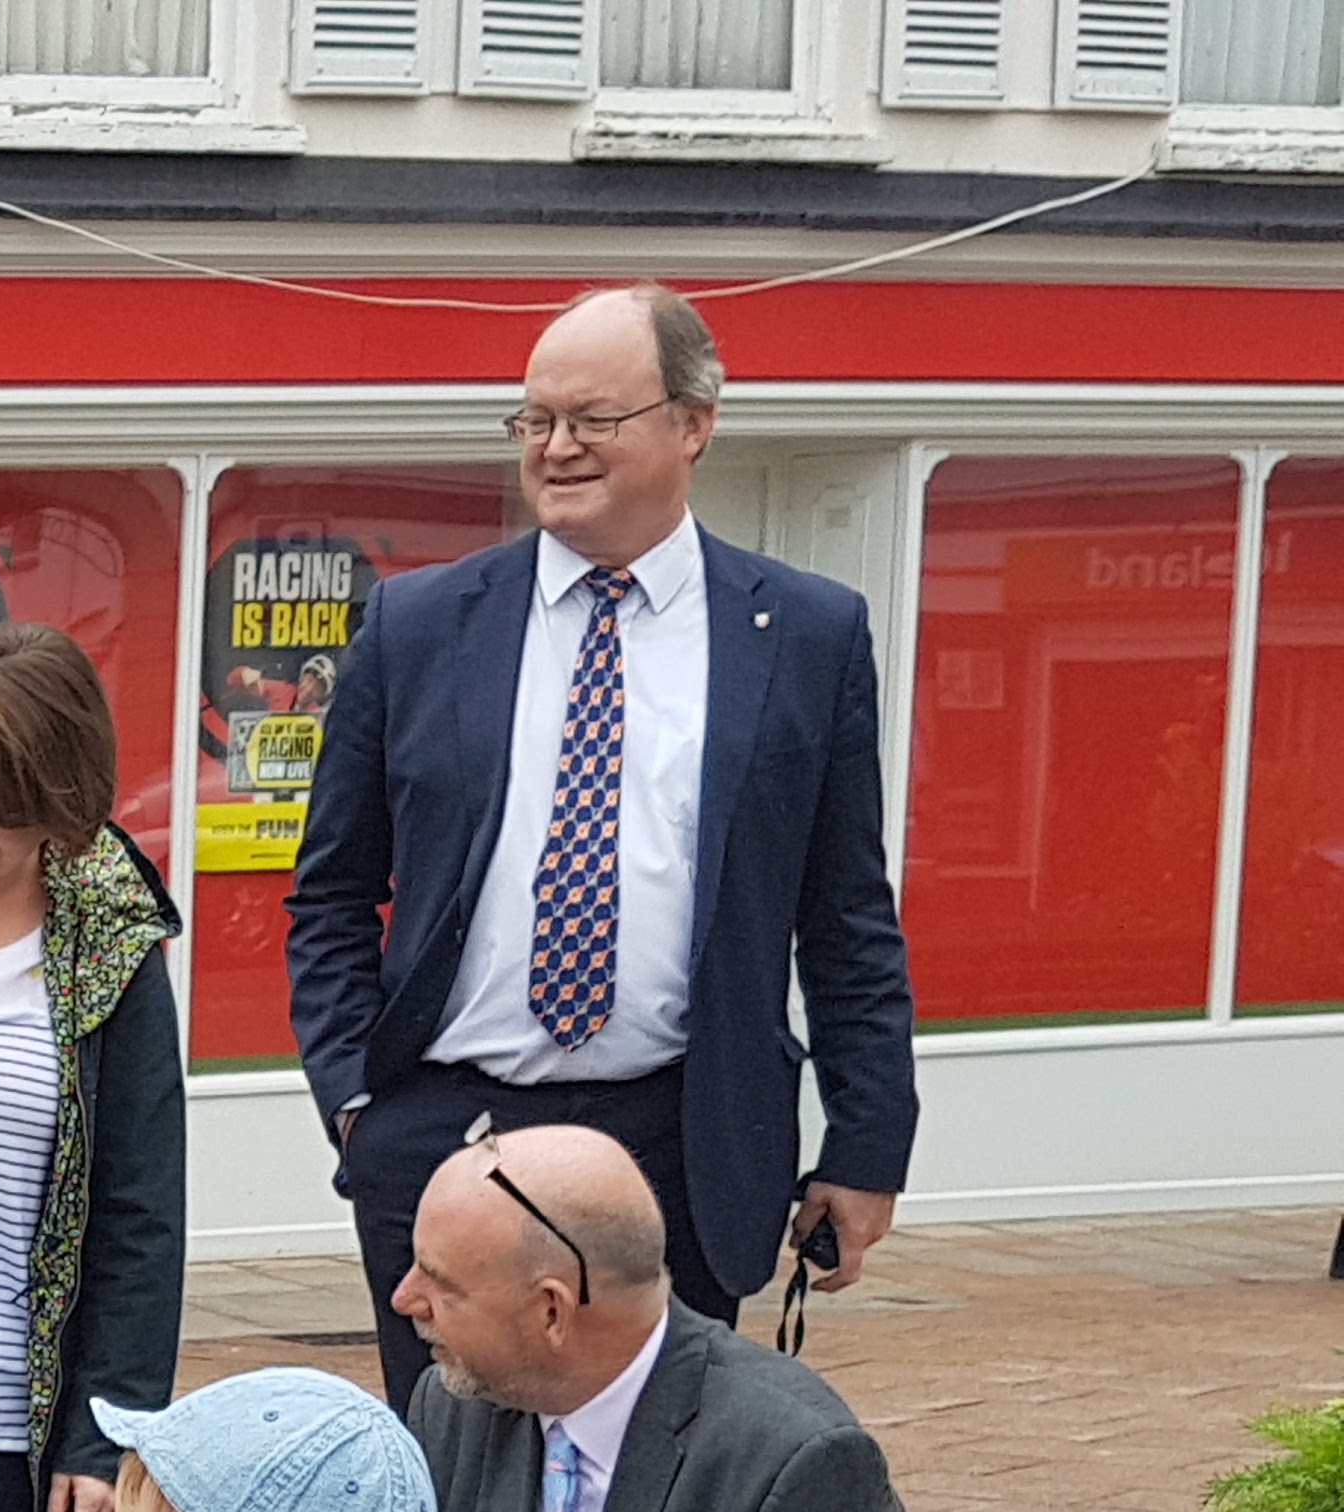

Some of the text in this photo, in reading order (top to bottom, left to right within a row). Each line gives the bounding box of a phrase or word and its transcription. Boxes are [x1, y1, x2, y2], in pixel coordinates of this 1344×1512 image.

[234, 552, 353, 600] RACING
[232, 602, 350, 647] IS BACK
[259, 736, 314, 758] RACING
[255, 819, 299, 839] FUN
